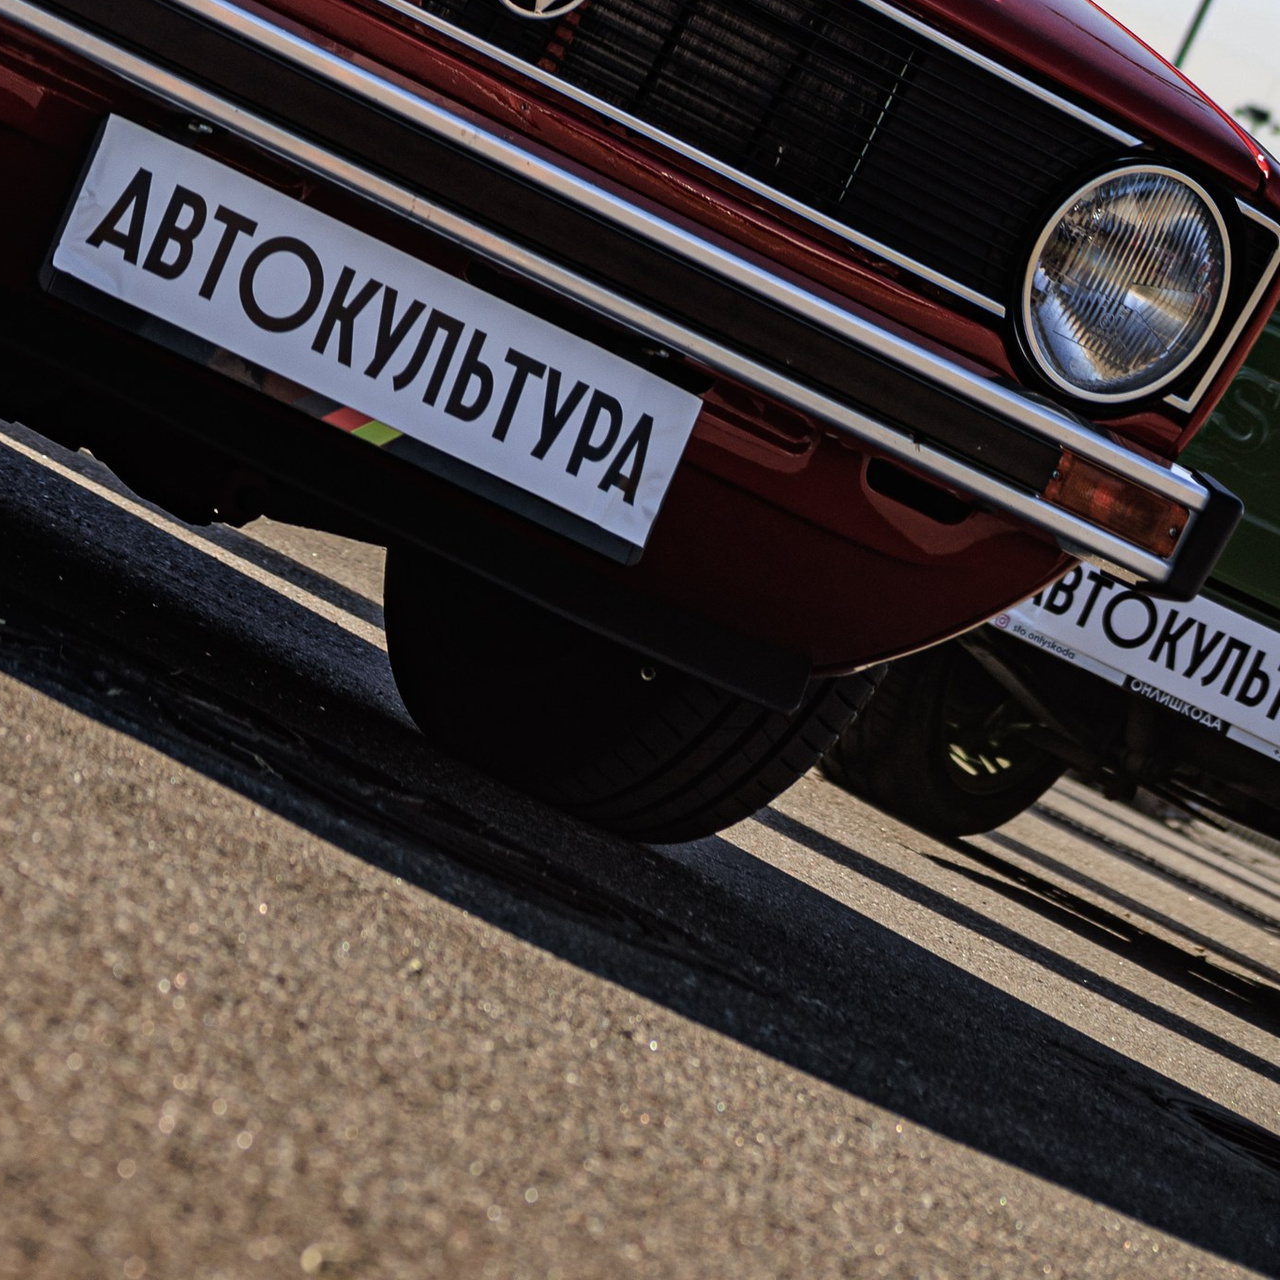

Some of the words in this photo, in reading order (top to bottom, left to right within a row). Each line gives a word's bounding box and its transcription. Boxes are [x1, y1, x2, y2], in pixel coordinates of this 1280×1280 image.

[86, 166, 657, 507] АВТОКУЛЬТУРА
[1012, 623, 1076, 661] sto.onlyskoda
[1031, 567, 1280, 722] ВТОКУЛЬ
